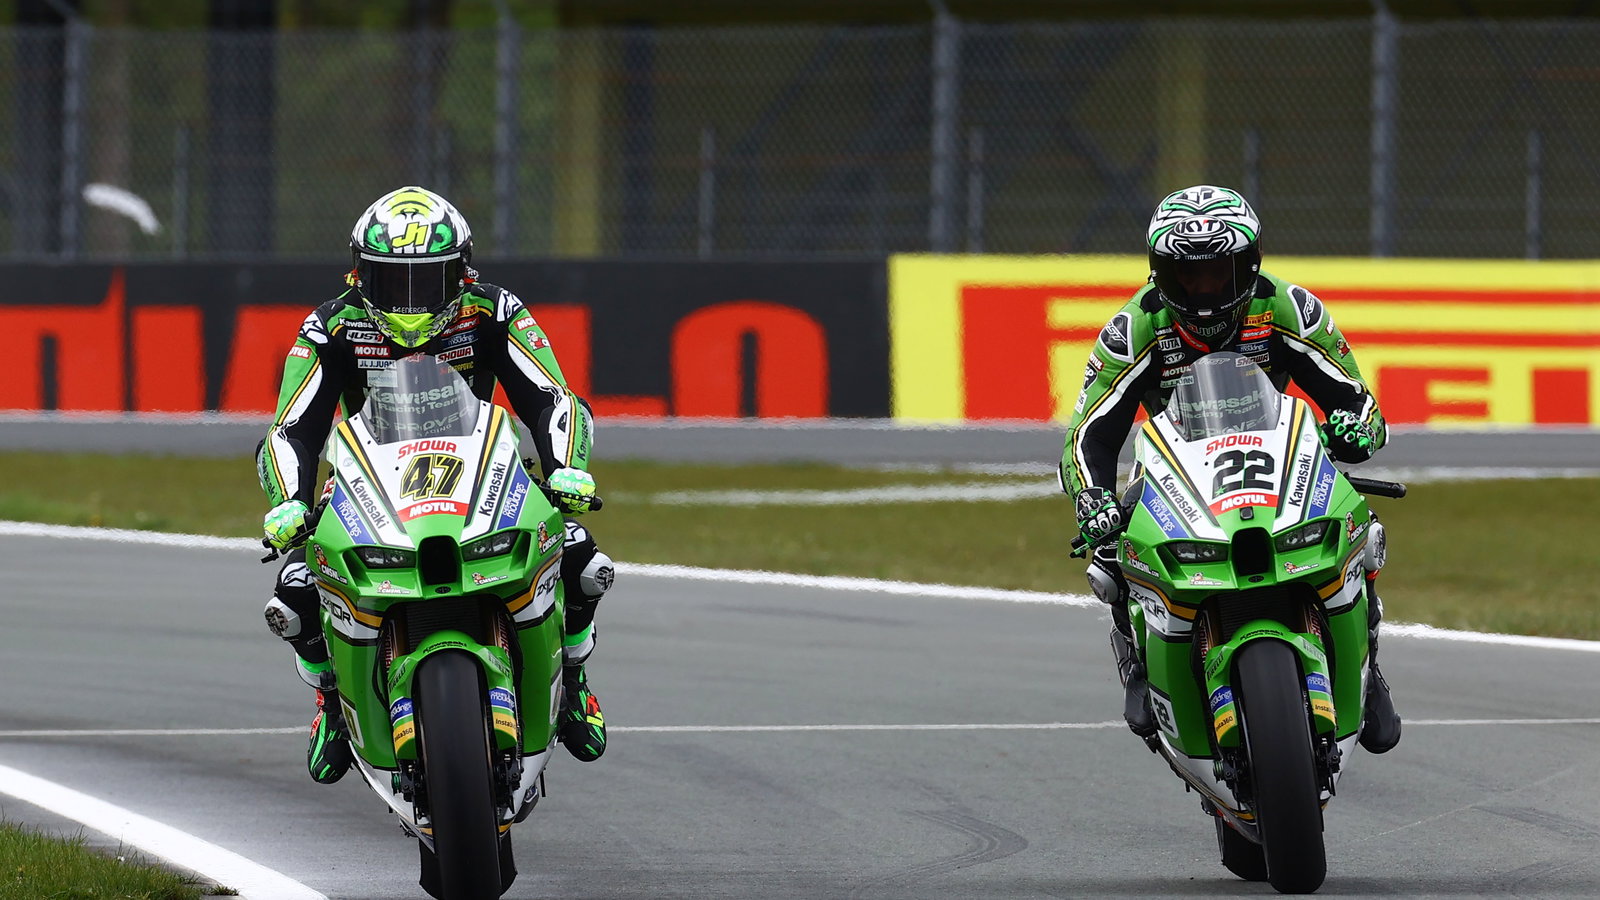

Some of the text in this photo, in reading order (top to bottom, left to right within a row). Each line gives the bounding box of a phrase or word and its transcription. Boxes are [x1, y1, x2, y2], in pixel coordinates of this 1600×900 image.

[1179, 219, 1219, 233] KYT
[354, 346, 389, 356] MOTUL
[437, 347, 472, 363] SHOWA
[1160, 338, 1181, 351] JUTA
[398, 440, 457, 460] SHOWA
[1206, 434, 1263, 457] SHOWA
[400, 453, 464, 501] 47
[1212, 450, 1275, 500] 22
[1288, 453, 1312, 507] Kawasaki
[479, 462, 507, 516] Kawasaki
[1160, 473, 1202, 523] Kawasaki
[350, 476, 389, 529] Kawasaki
[409, 502, 457, 517] MOTUL
[1221, 494, 1268, 511] MOTUL
